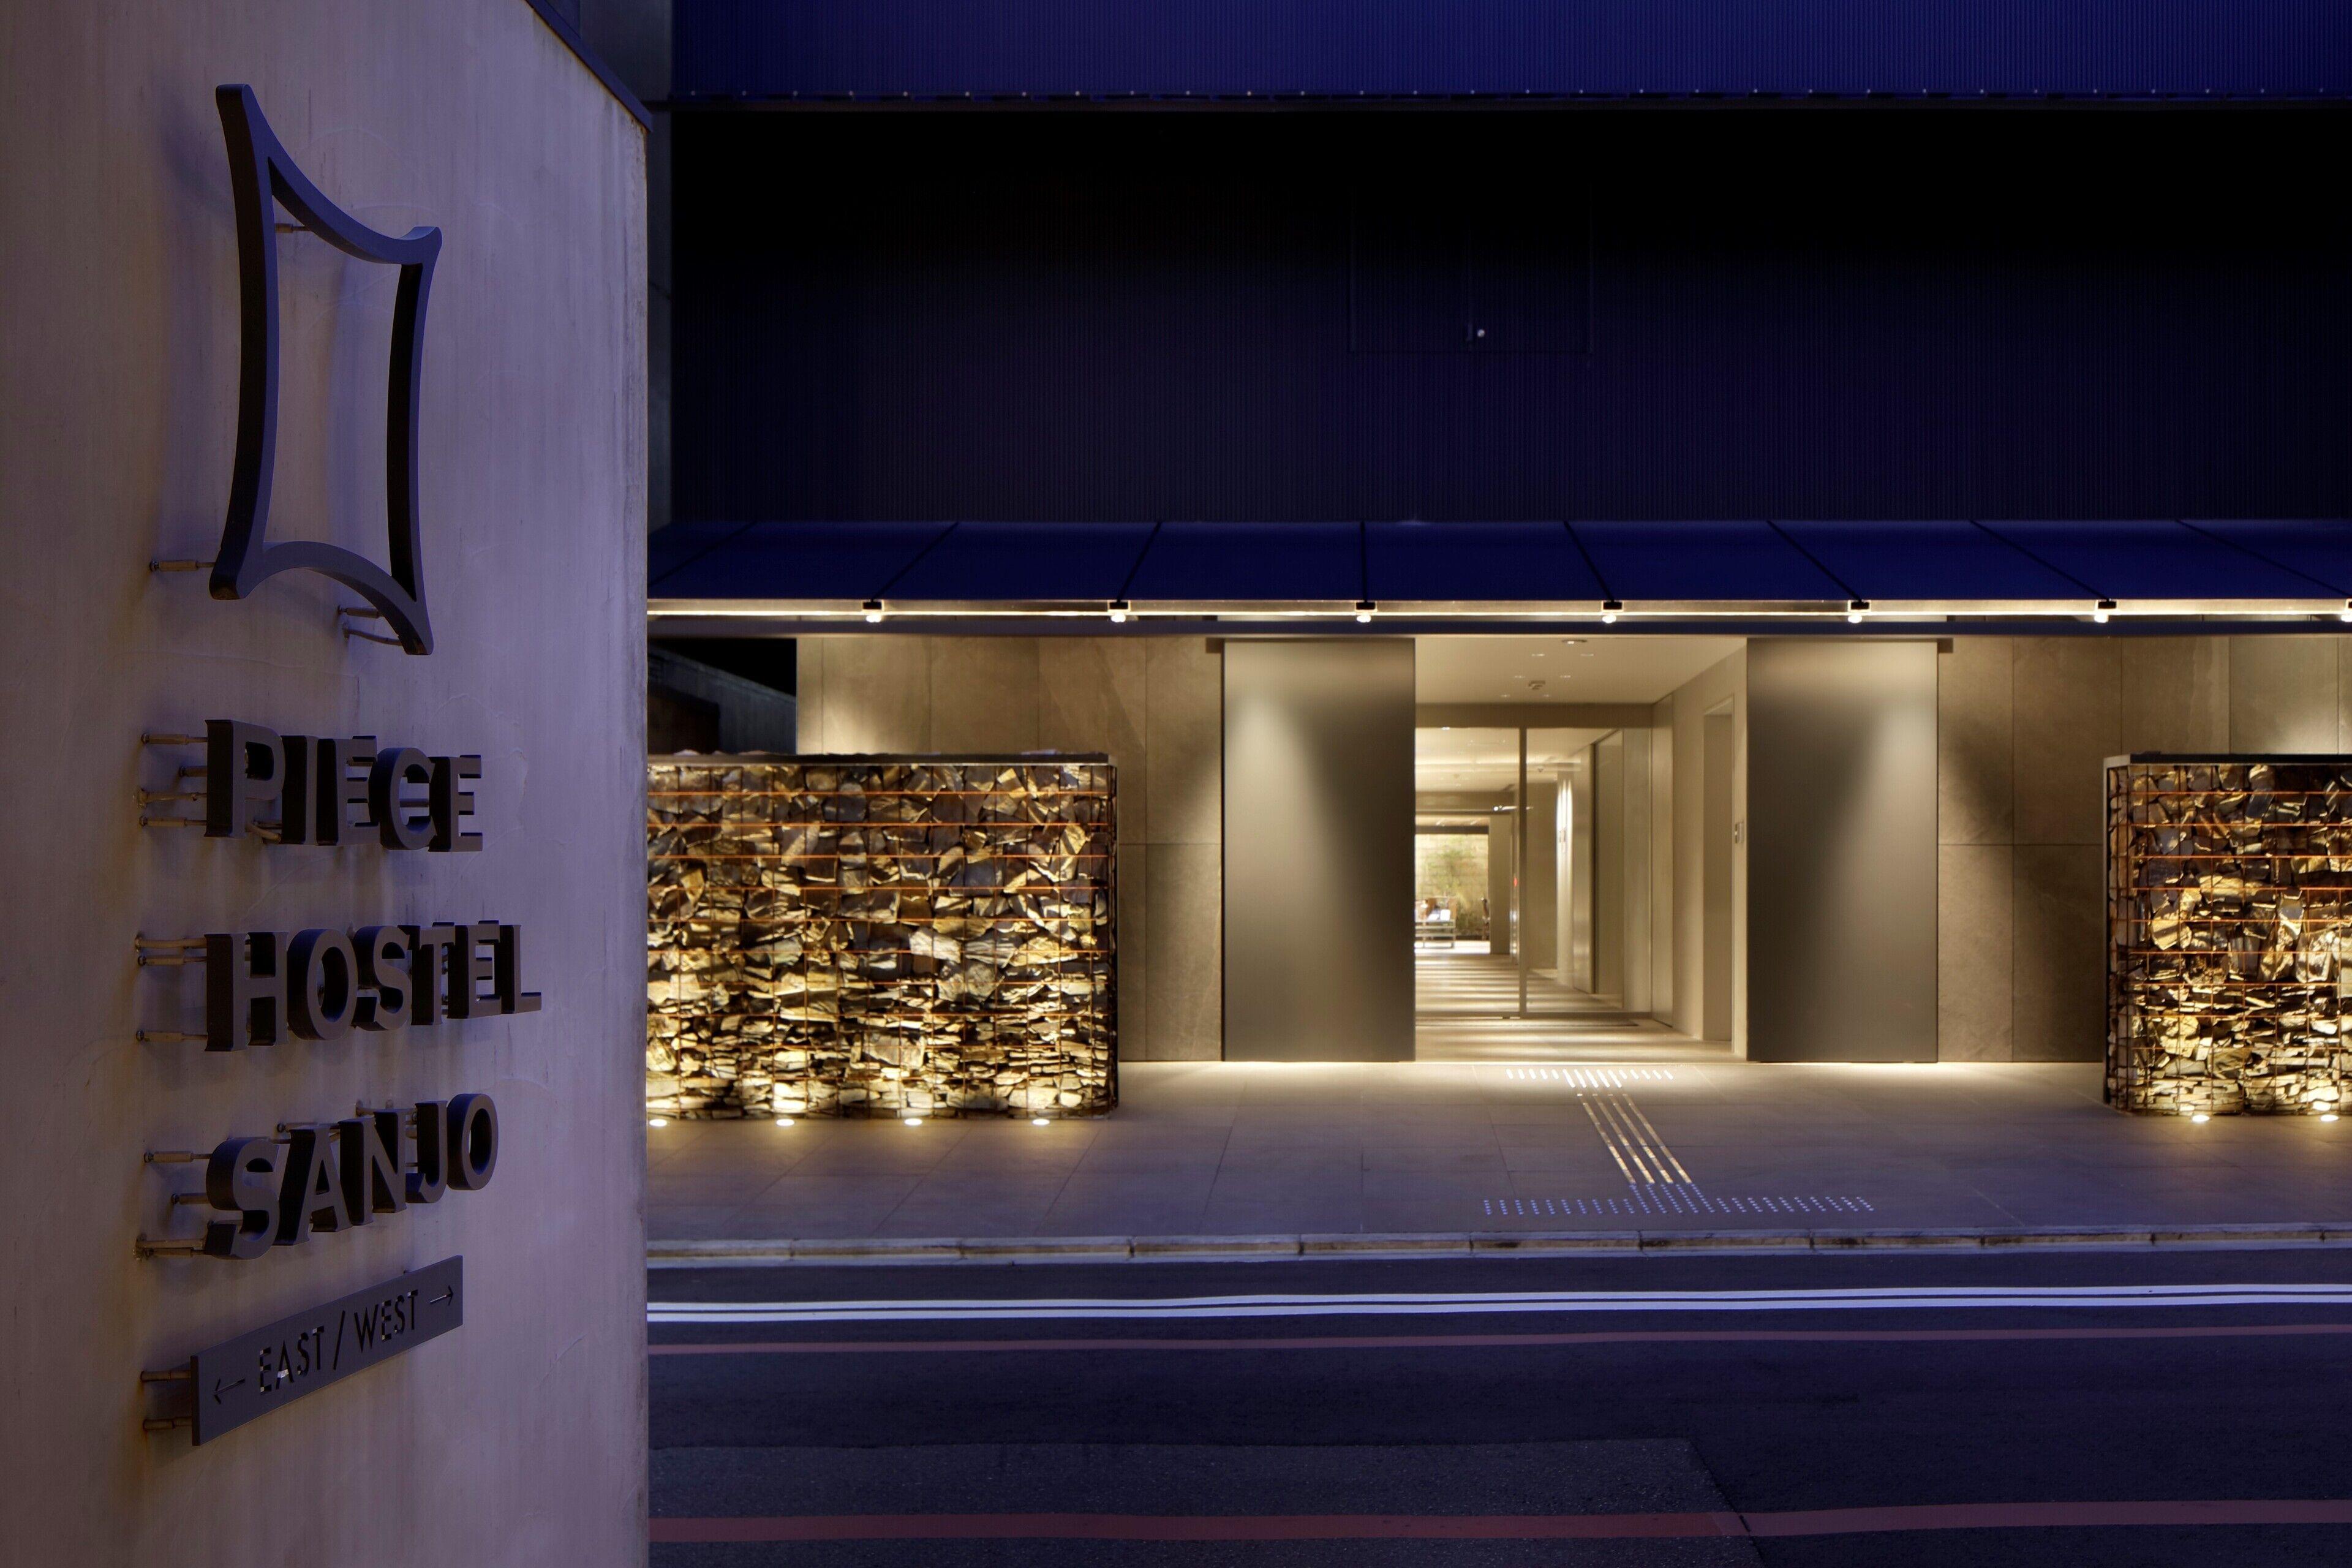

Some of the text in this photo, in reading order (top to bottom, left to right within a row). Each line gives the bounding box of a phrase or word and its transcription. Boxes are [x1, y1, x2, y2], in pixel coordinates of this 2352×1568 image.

[205, 720, 483, 852] PIECE
[205, 920, 541, 1051] HOSTEL
[205, 1093, 498, 1260] SANJO
